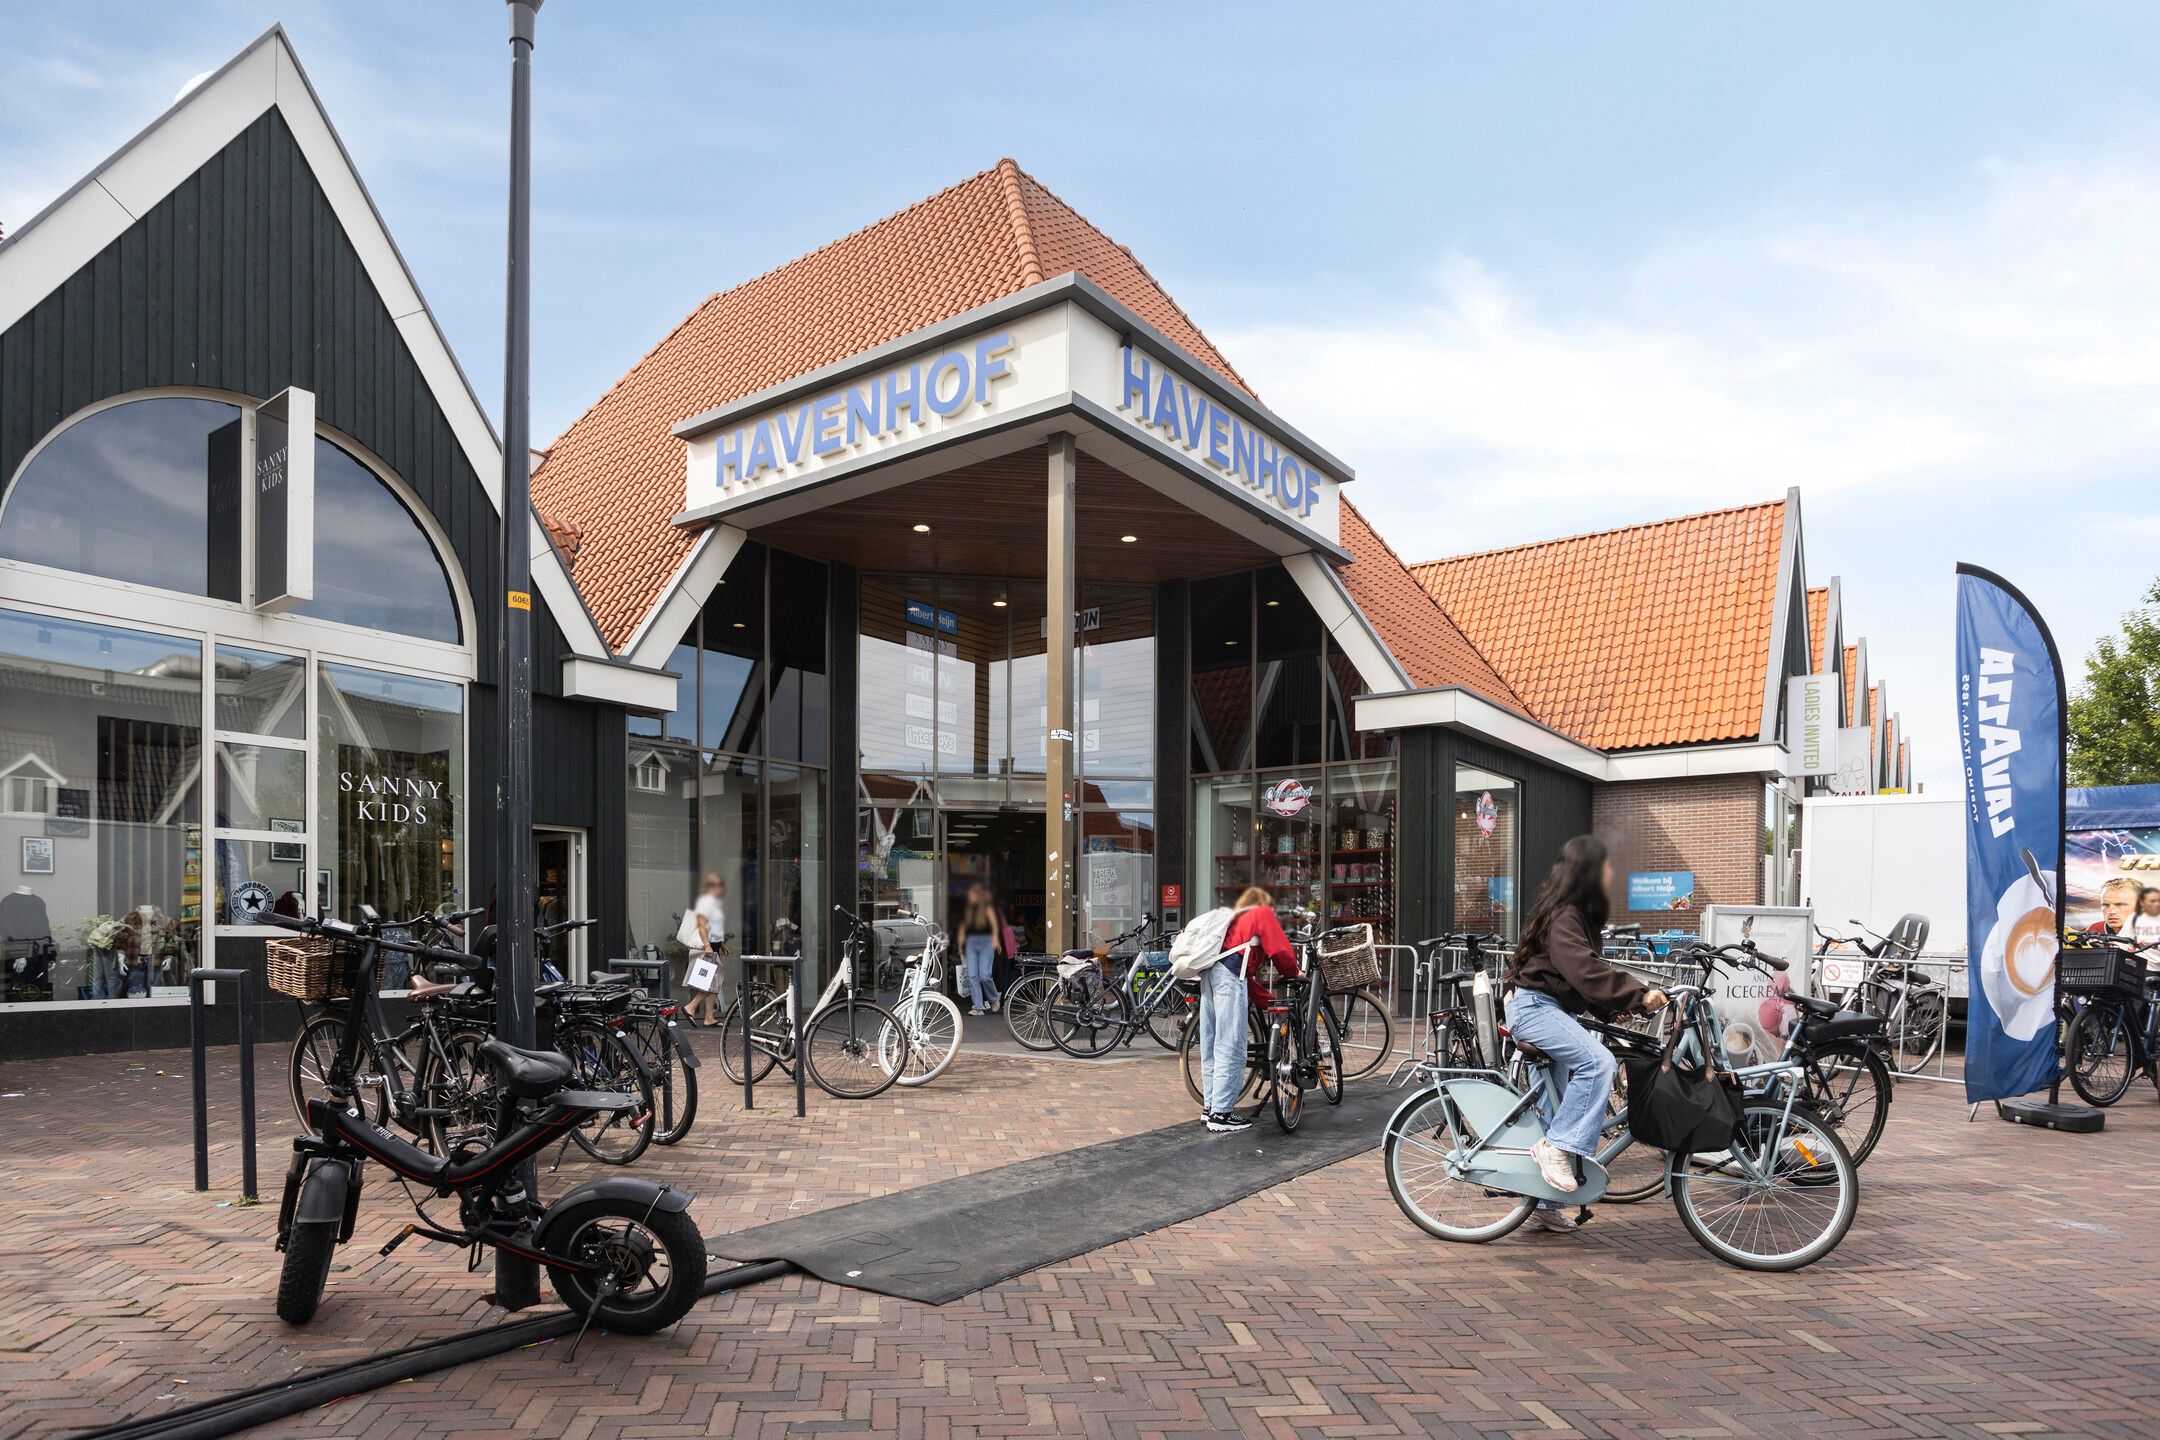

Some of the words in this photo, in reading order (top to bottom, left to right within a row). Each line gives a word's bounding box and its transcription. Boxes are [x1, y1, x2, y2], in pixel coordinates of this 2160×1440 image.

[716, 331, 1015, 489] HAVENHOF
[1120, 345, 1321, 518] HAVENHOF
[257, 446, 288, 476] SANNY
[261, 469, 284, 492] KIDS
[1803, 681, 1821, 722] LADIES
[1803, 724, 1820, 769] INVITED
[340, 771, 443, 800] SANNY
[357, 800, 427, 825] KIDS
[1752, 974, 1769, 982] AND
